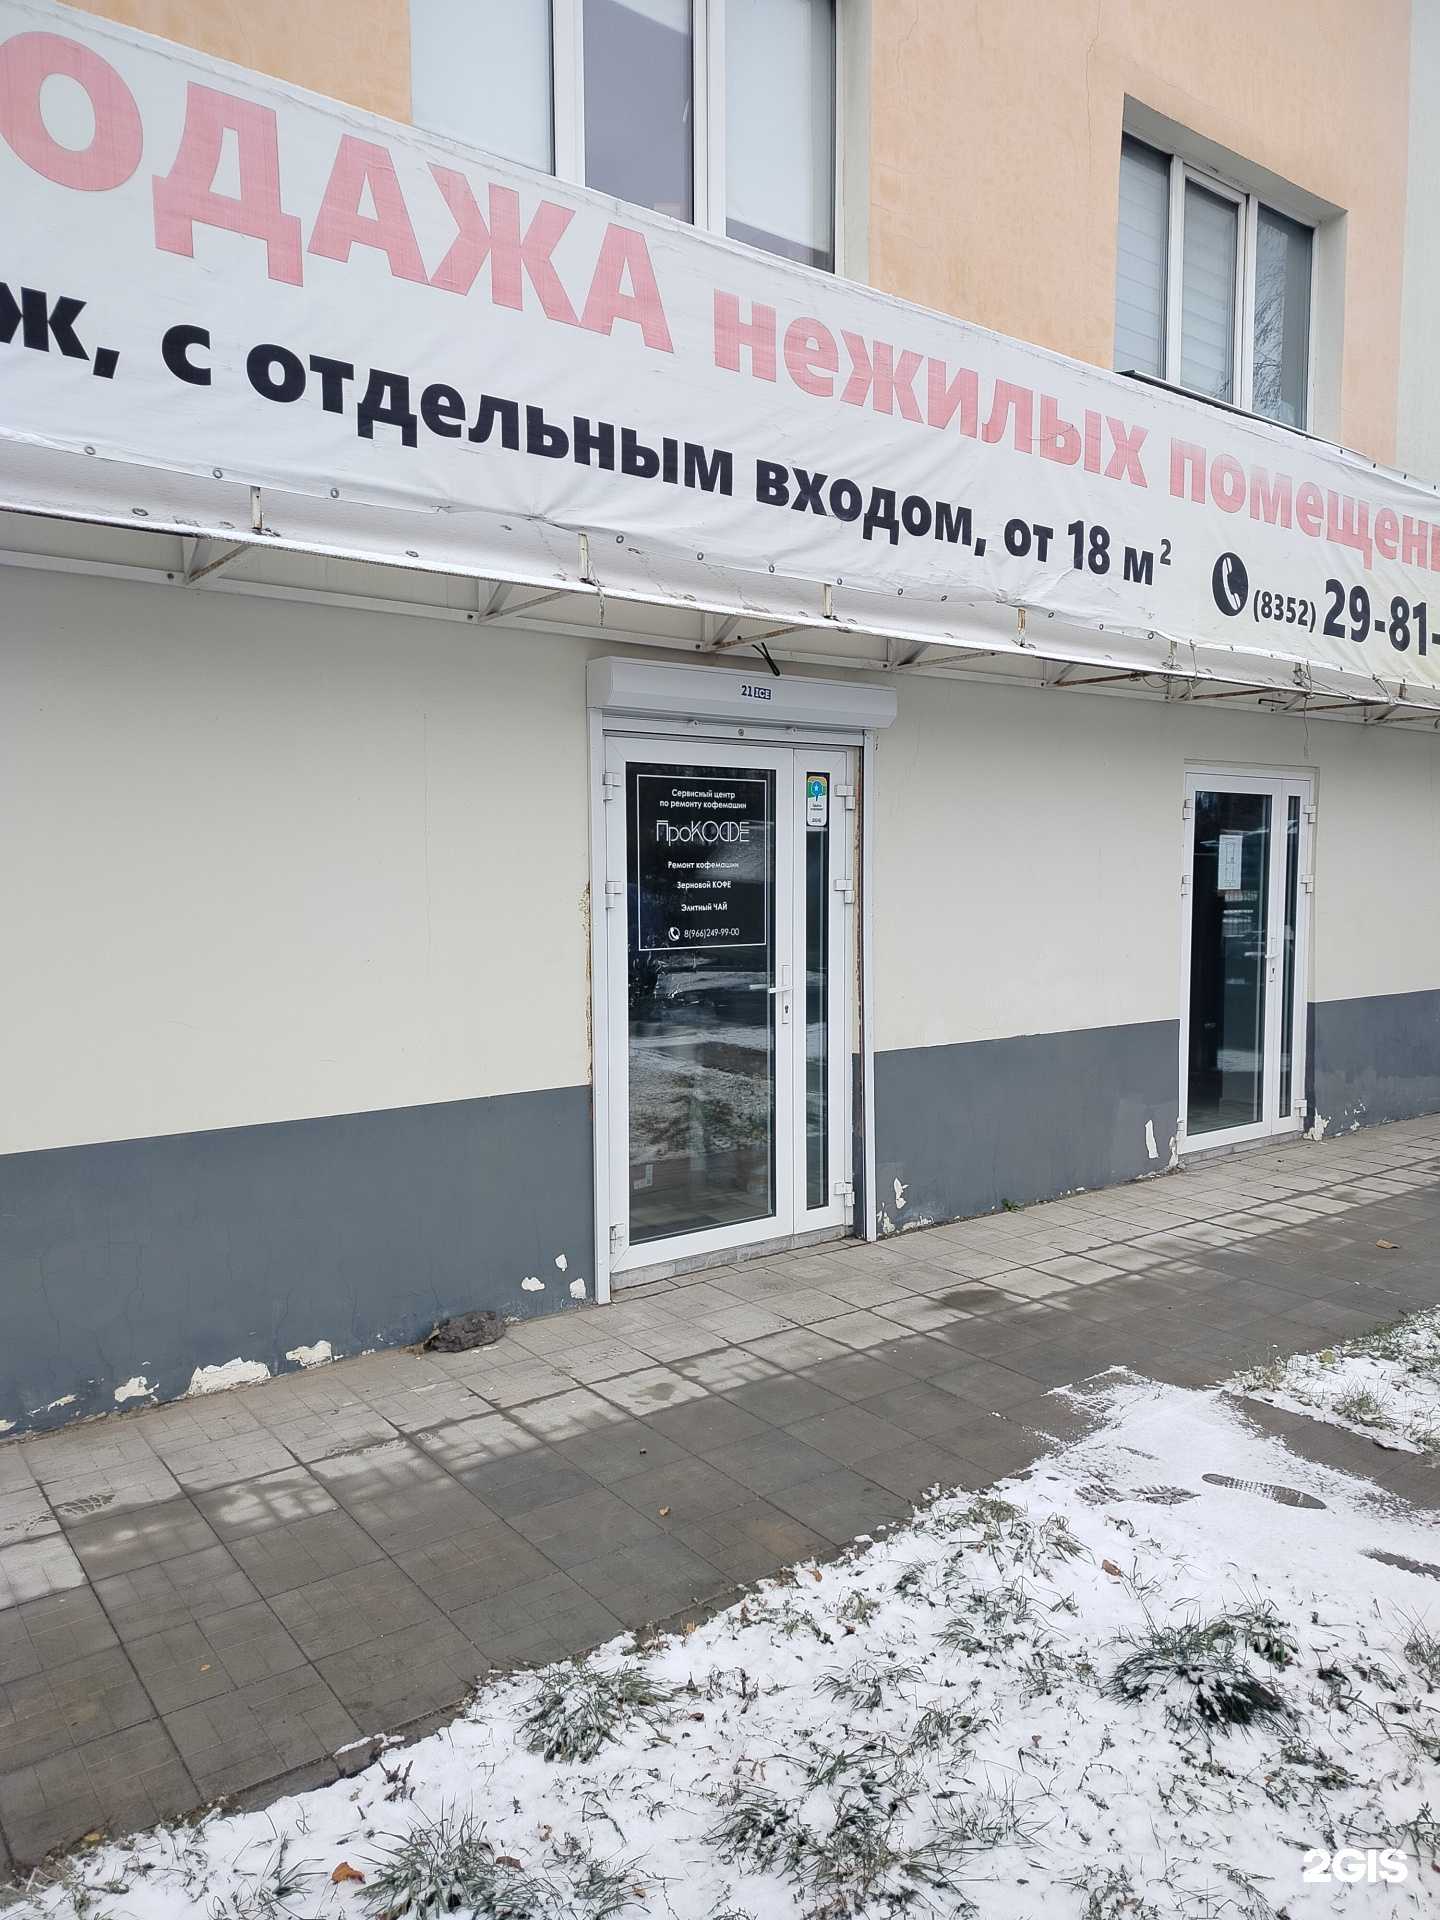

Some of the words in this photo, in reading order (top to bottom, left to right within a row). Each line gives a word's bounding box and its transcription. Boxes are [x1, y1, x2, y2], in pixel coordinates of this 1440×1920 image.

[713, 288, 1149, 488] нежилых
[1169, 437, 1440, 573] помещен
[161, 324, 212, 386] с
[246, 344, 733, 496] отдельным
[756, 459, 987, 557] входом,
[1004, 518, 1054, 562] от
[1068, 520, 1110, 575] 18
[1253, 589, 1316, 633] (8352)
[671, 788, 713, 799] Сервисный
[713, 792, 736, 800] центр
[659, 800, 670, 808] по
[670, 801, 702, 809] ремонту
[703, 802, 747, 810] кофемашин
[656, 819, 750, 847] ПроКОФЕ
[667, 861, 695, 869] Ремонт
[695, 861, 739, 870] кофемашин
[676, 881, 711, 891] Зерновой
[712, 880, 732, 889] КОФЕ
[681, 903, 712, 912] Элитный
[713, 901, 728, 911] ЧАЙ
[683, 928, 740, 939] 8(966)249-99-00
